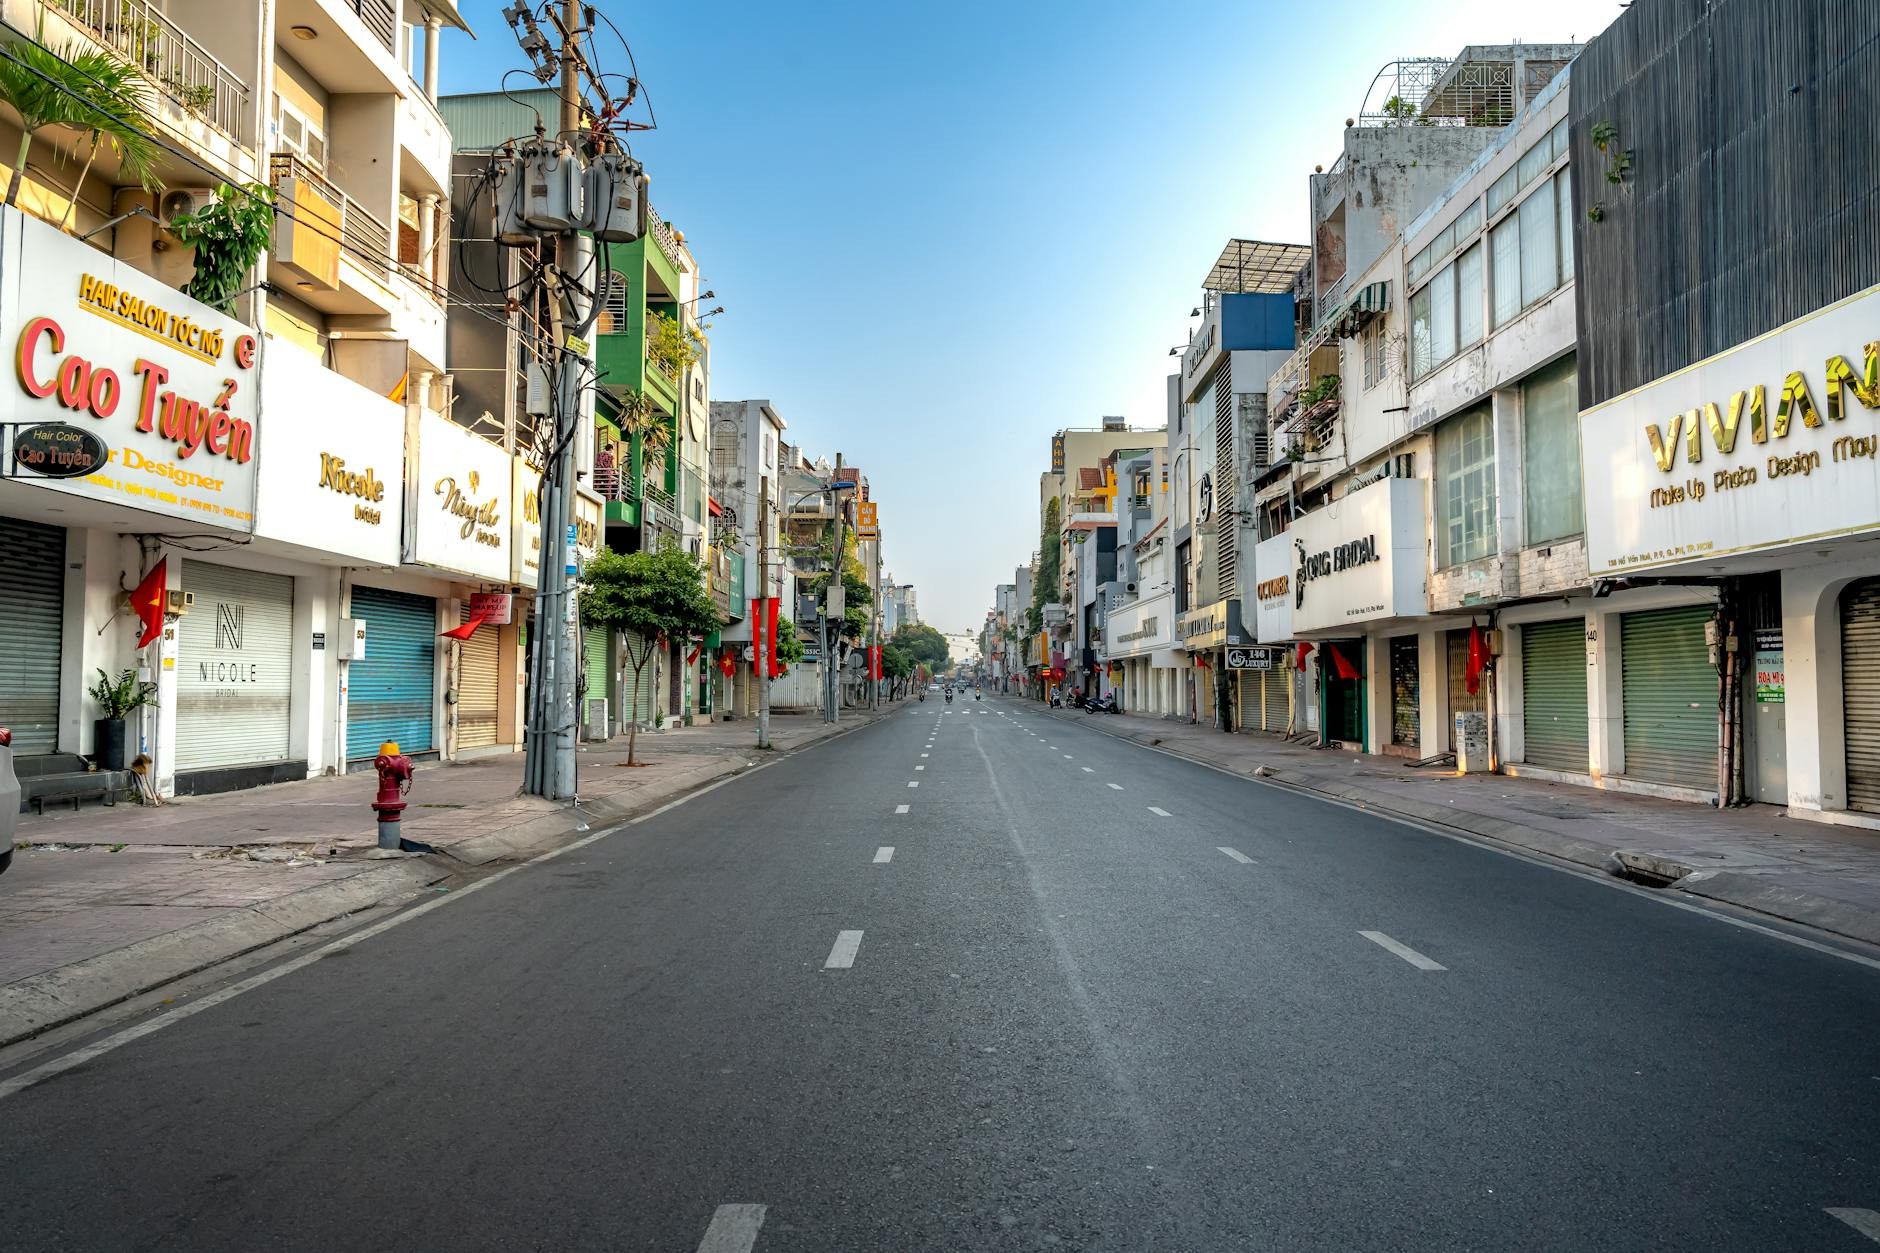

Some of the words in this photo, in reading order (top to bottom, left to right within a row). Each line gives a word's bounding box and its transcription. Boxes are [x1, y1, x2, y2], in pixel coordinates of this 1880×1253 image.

[79, 272, 119, 311] HAIR
[118, 289, 169, 334] SALON
[169, 314, 200, 347] TÓC
[17, 316, 121, 419] Cao
[33, 430, 54, 441] Hair
[56, 431, 82, 443] Color
[18, 443, 45, 464] Cao
[123, 447, 224, 492] Designer
[319, 452, 384, 502] Nicole
[1650, 485, 1684, 508] Make
[1686, 477, 1705, 502] Up
[1713, 466, 1757, 492] Photo
[1767, 449, 1821, 479] Design
[1333, 534, 1380, 572] BRIDAL
[1257, 575, 1290, 601] OCTOBER
[1244, 659, 1269, 668] LUXURY
[1249, 649, 1265, 659] 146
[200, 661, 257, 682] NICOLE
[215, 688, 240, 698] BRIDAL
